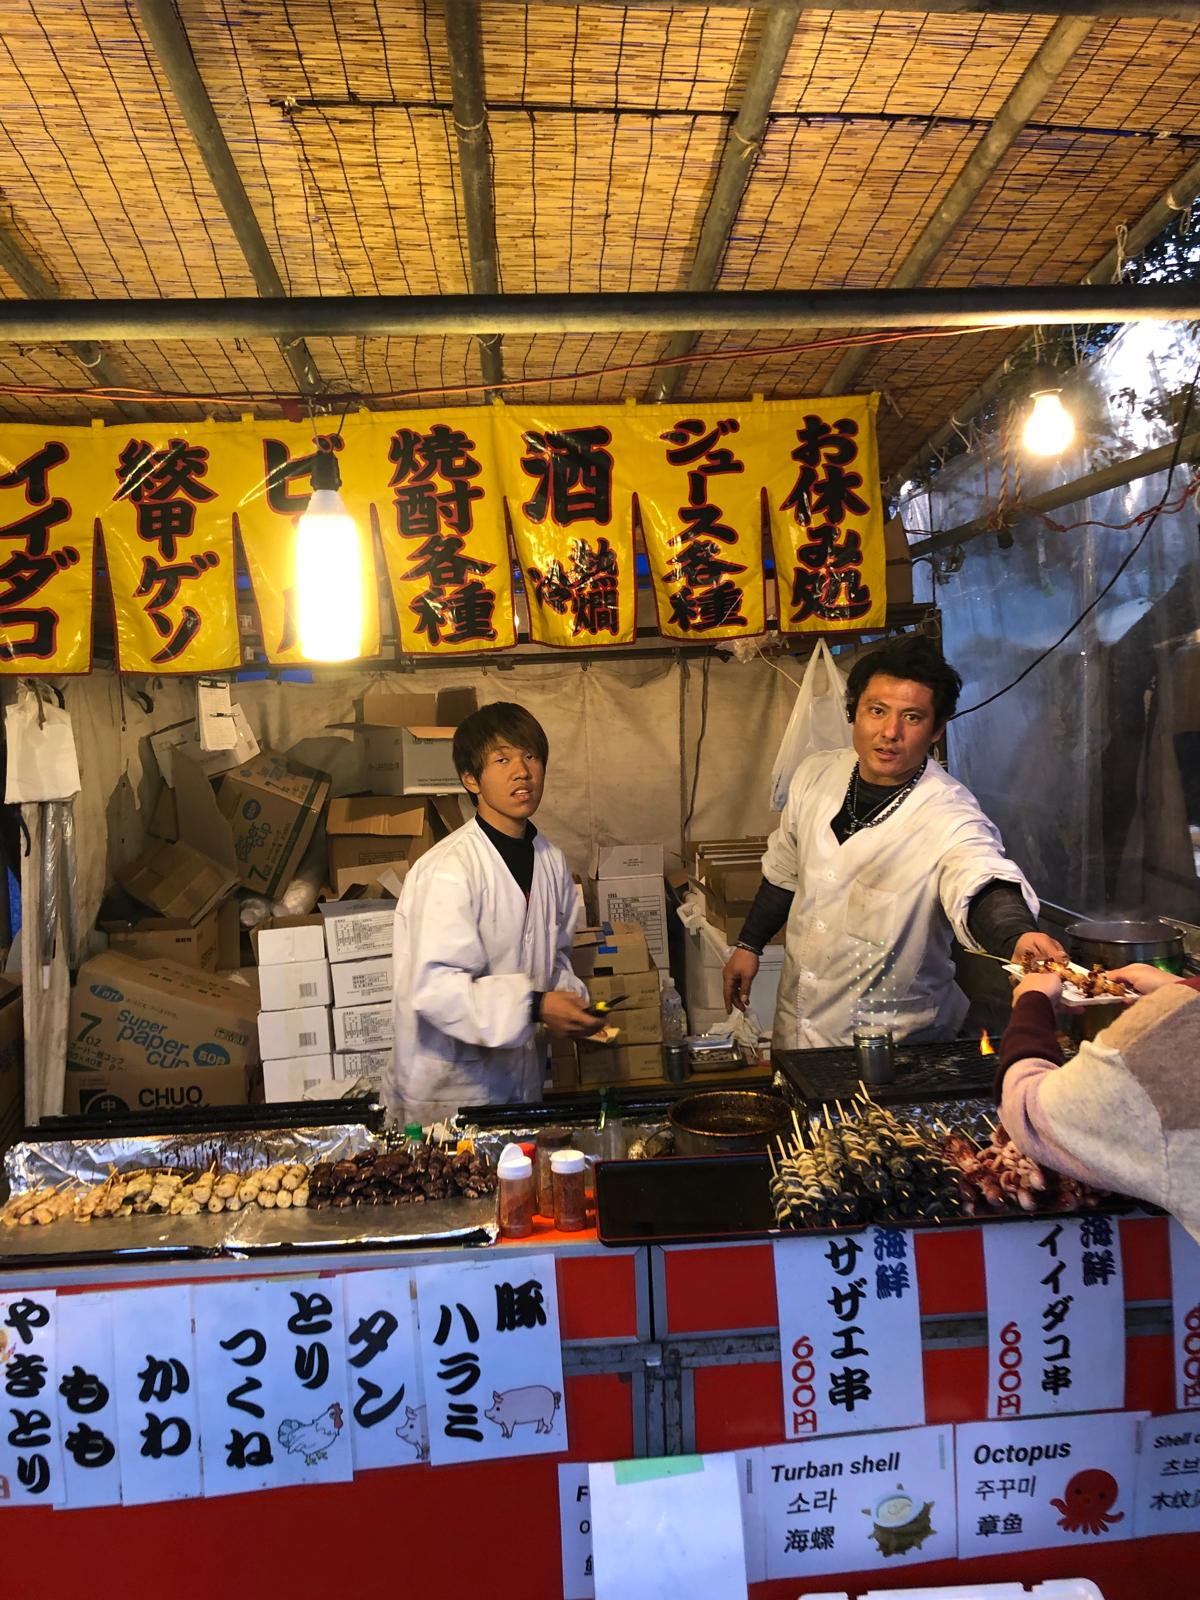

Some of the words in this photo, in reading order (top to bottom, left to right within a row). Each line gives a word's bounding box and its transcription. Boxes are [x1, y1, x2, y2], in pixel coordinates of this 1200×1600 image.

[520, 425, 613, 528] 酒
[659, 418, 750, 632] ジュース各種
[779, 414, 872, 624] お休み処
[0, 441, 80, 661] イイダコ
[388, 424, 497, 646] 焼酎各種
[77, 1013, 102, 1042] 7
[117, 1024, 190, 1057] paper
[138, 1086, 203, 1107] CHUO
[287, 1291, 333, 1390] とり
[494, 1279, 547, 1332] 豚
[824, 1237, 873, 1412] サザエ串
[1037, 1224, 1075, 1396] イイダコ串
[4, 1297, 51, 1494] やきとり
[59, 1365, 116, 1468] もも
[137, 1355, 192, 1459] かわ
[219, 1328, 274, 1469] つくね
[348, 1310, 405, 1429] タン
[432, 1303, 484, 1443] ハラミ
[791, 1335, 818, 1435] 600円
[998, 1321, 1023, 1416] 600円
[771, 1463, 843, 1483] Turban
[850, 1452, 901, 1475] shell
[786, 1488, 838, 1514] 소라
[973, 1442, 1072, 1468] Octopus
[975, 1475, 1037, 1502] 주꾸미
[784, 1525, 836, 1554] 海螺
[976, 1512, 1024, 1538] 章鱼
